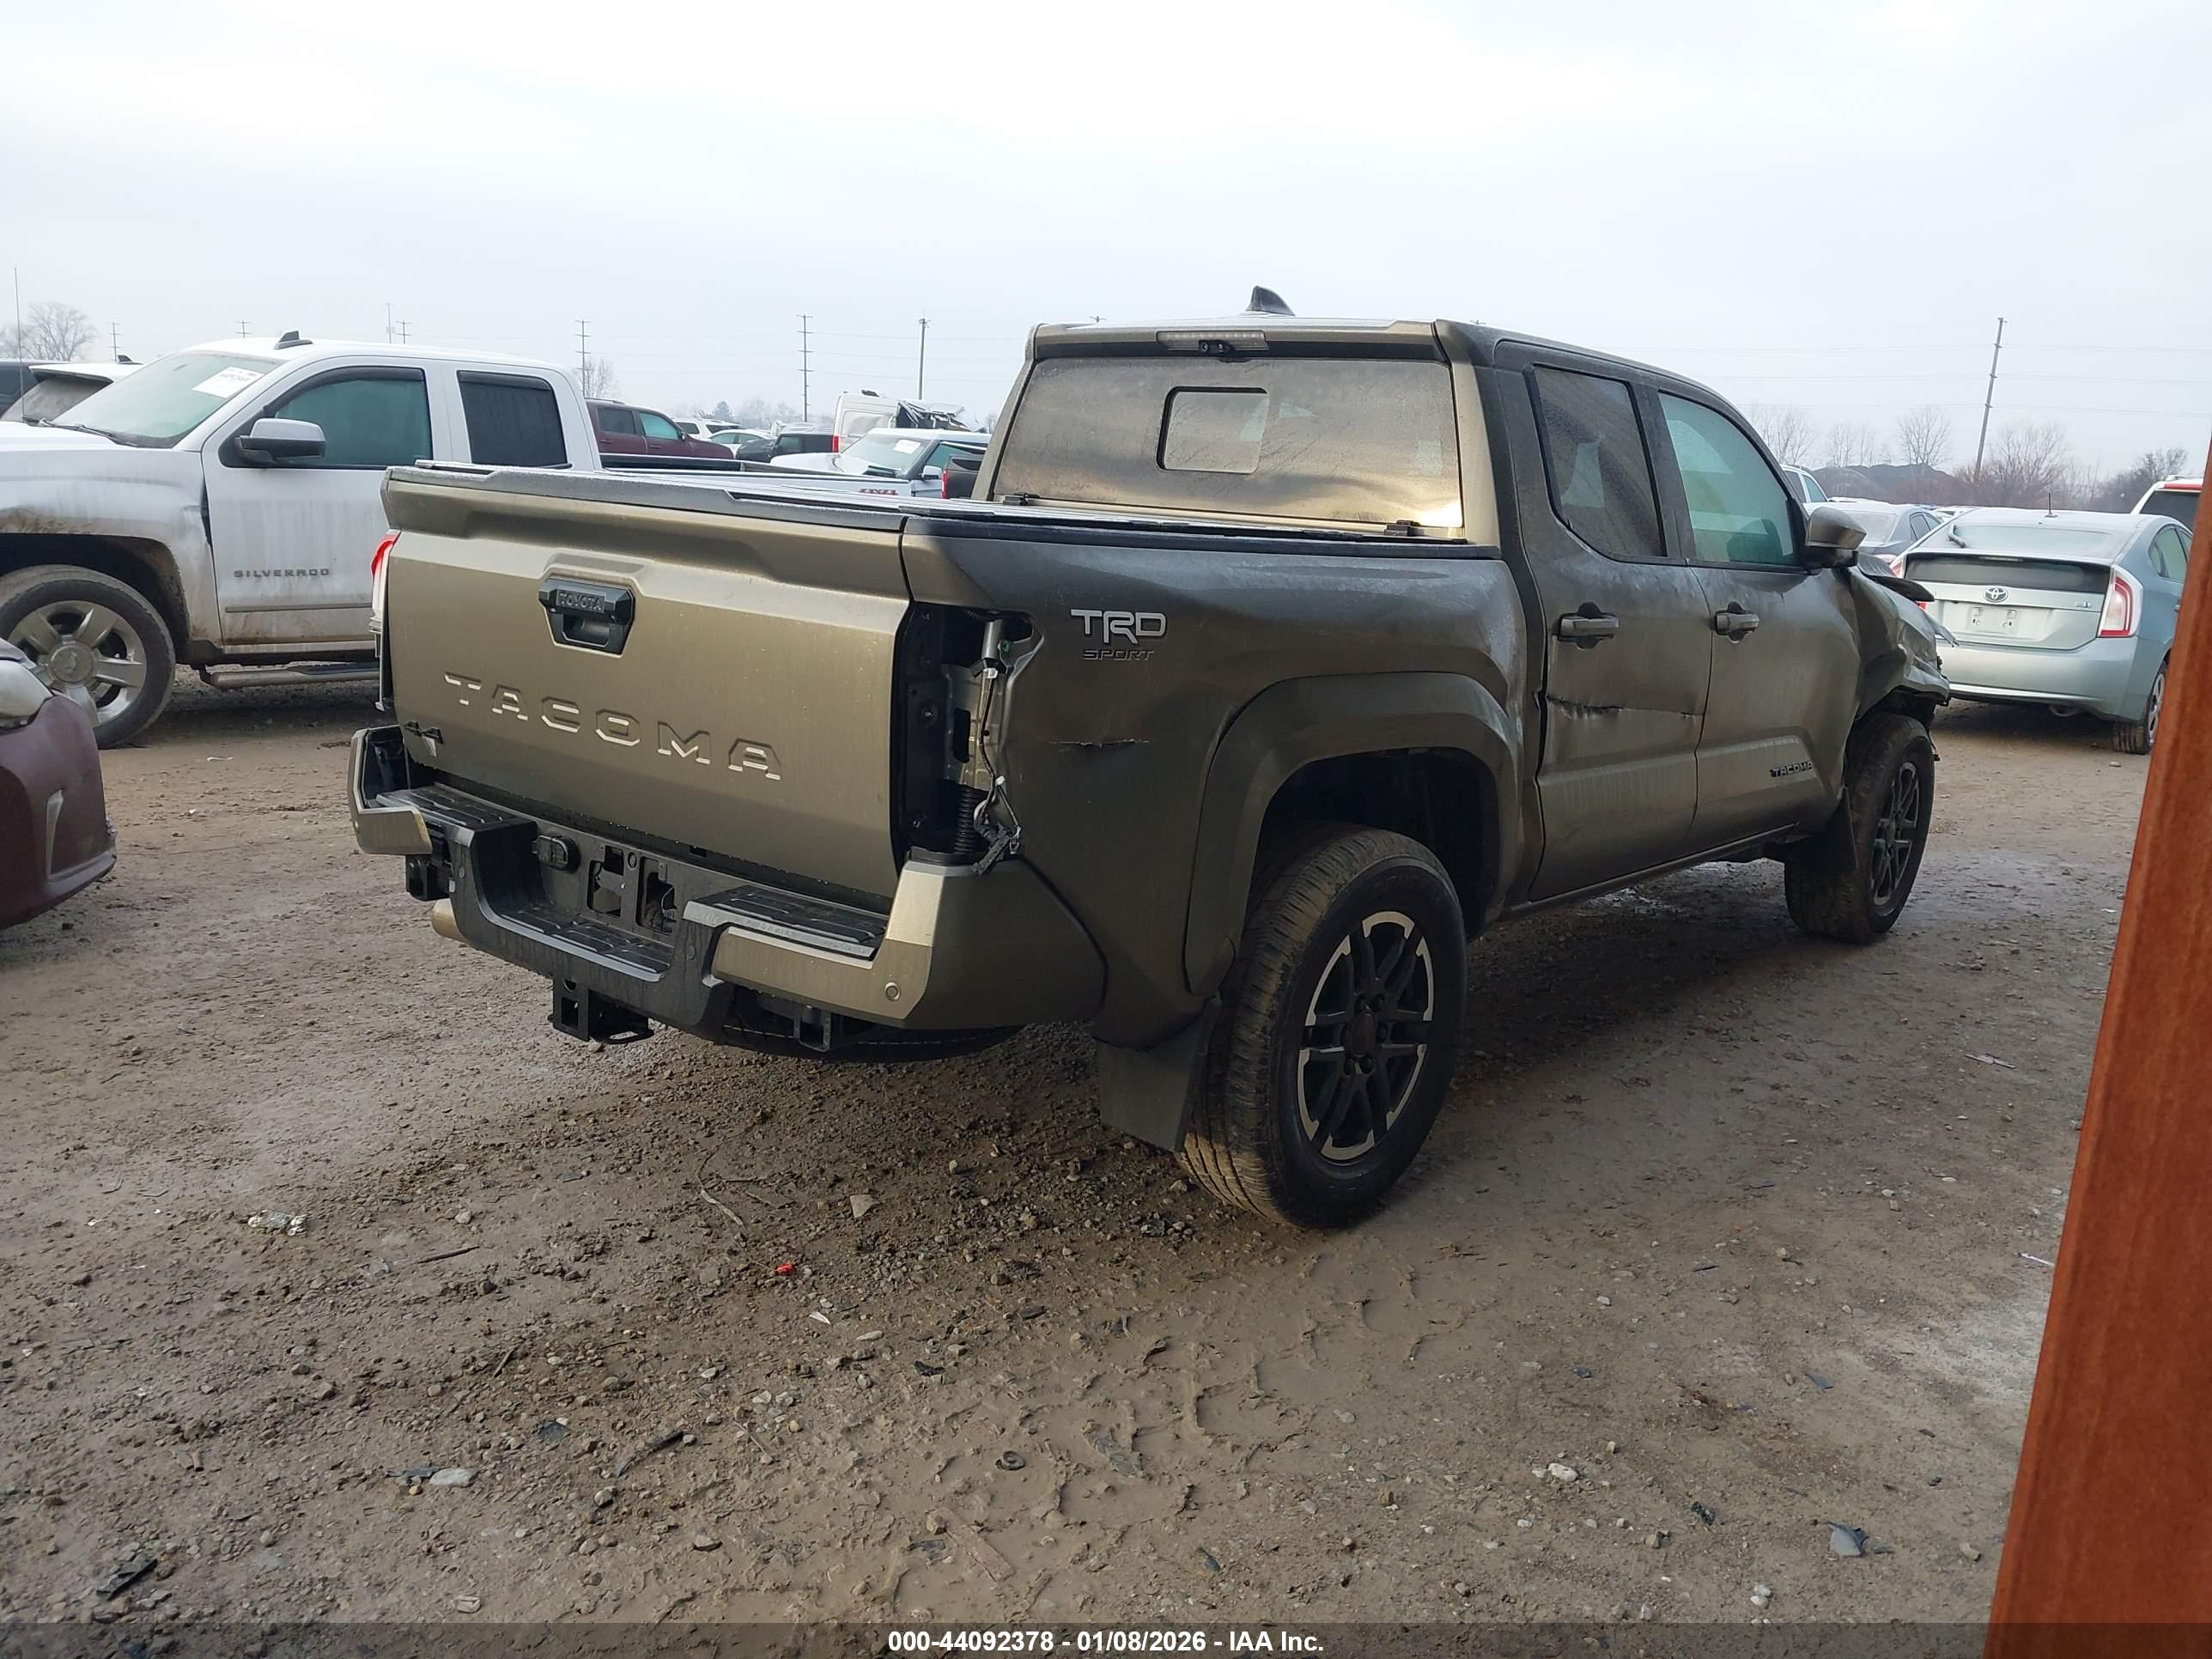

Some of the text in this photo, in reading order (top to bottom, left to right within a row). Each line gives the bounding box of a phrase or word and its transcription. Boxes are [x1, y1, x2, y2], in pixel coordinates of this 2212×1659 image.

[234, 568, 330, 578] SILVERADO
[558, 591, 602, 611] TOYOTA
[1070, 608, 1167, 644] TRD
[1083, 649, 1155, 661] SPORT
[443, 671, 782, 781] TACOMA
[1771, 761, 1814, 778] TACOMA
